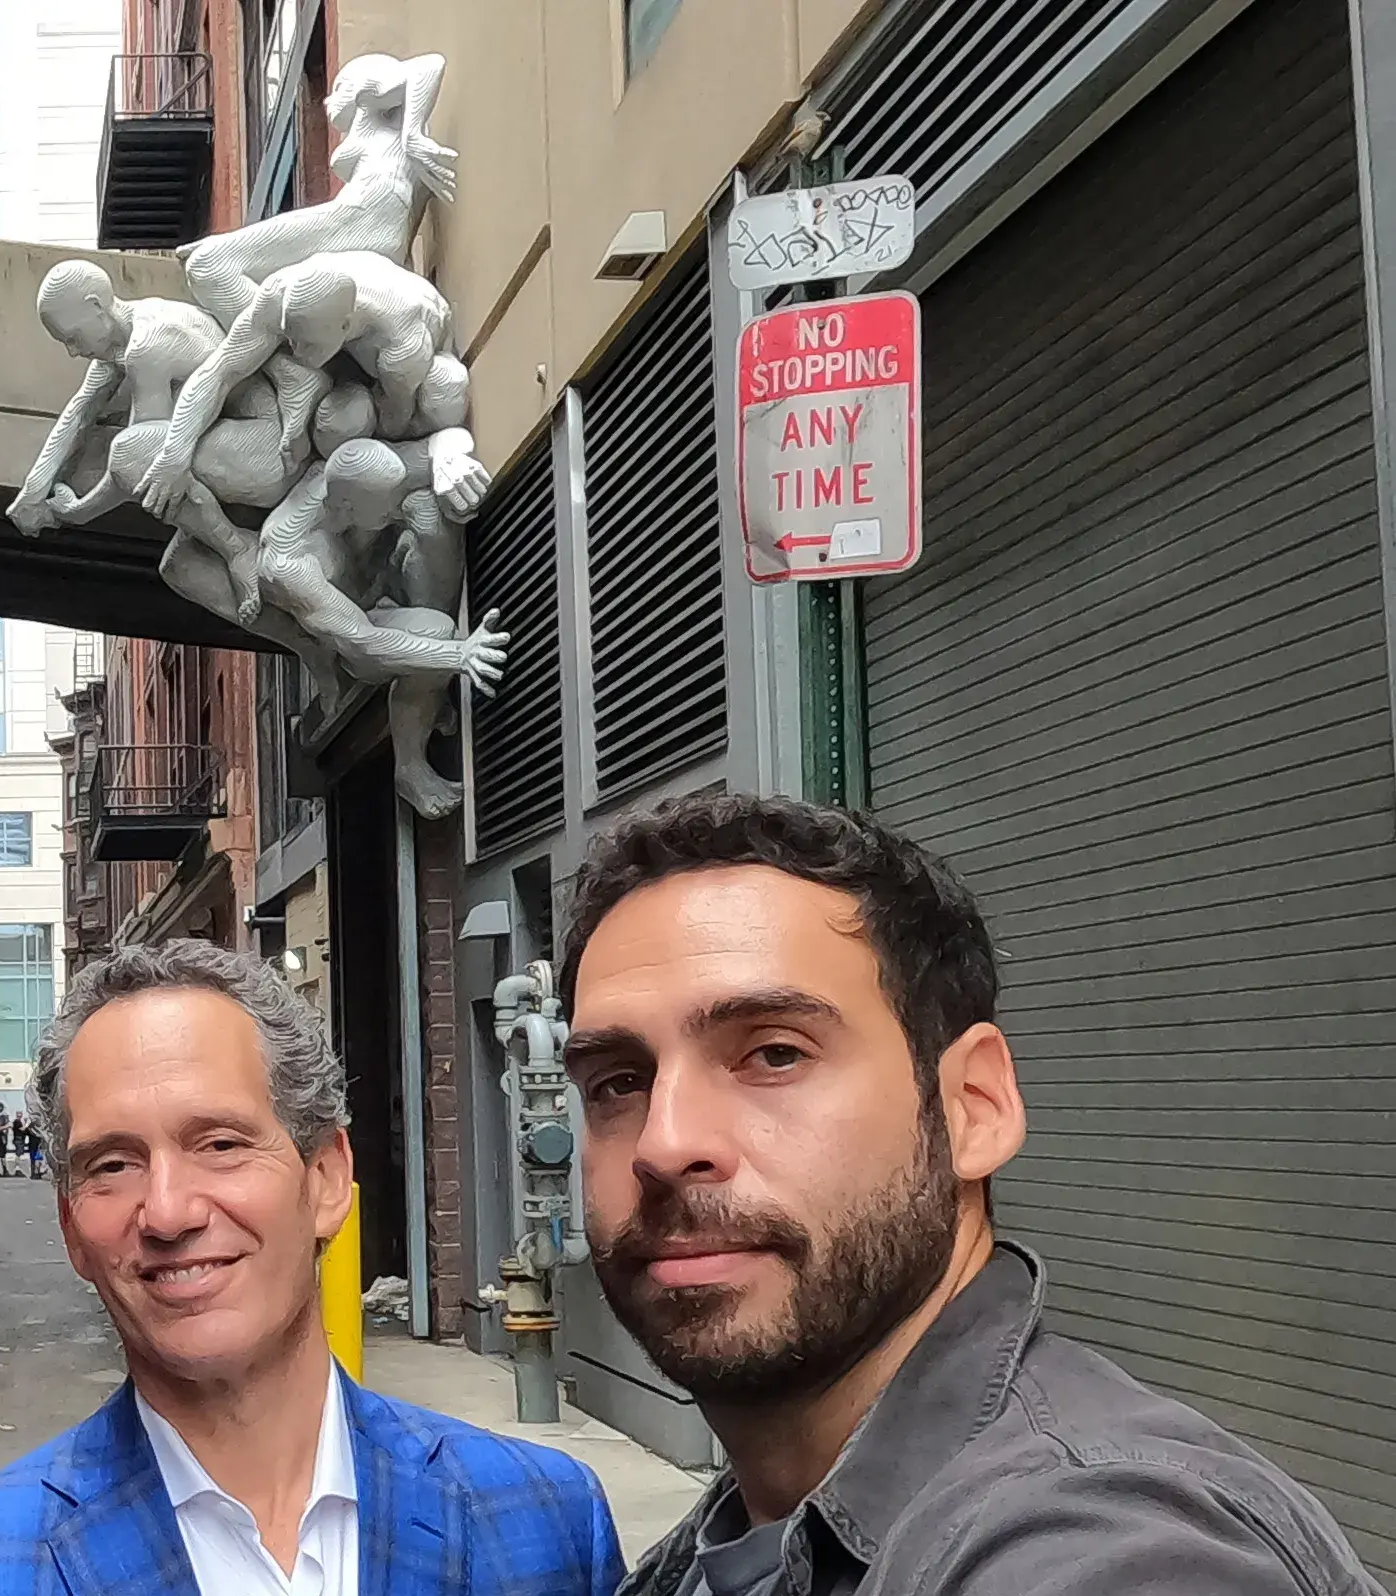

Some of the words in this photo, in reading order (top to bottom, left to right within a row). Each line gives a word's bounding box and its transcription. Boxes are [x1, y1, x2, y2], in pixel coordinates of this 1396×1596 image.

[798, 312, 844, 351] NO
[750, 345, 898, 397] STOPPING
[780, 403, 863, 452] ANY
[772, 463, 874, 511] TIME
